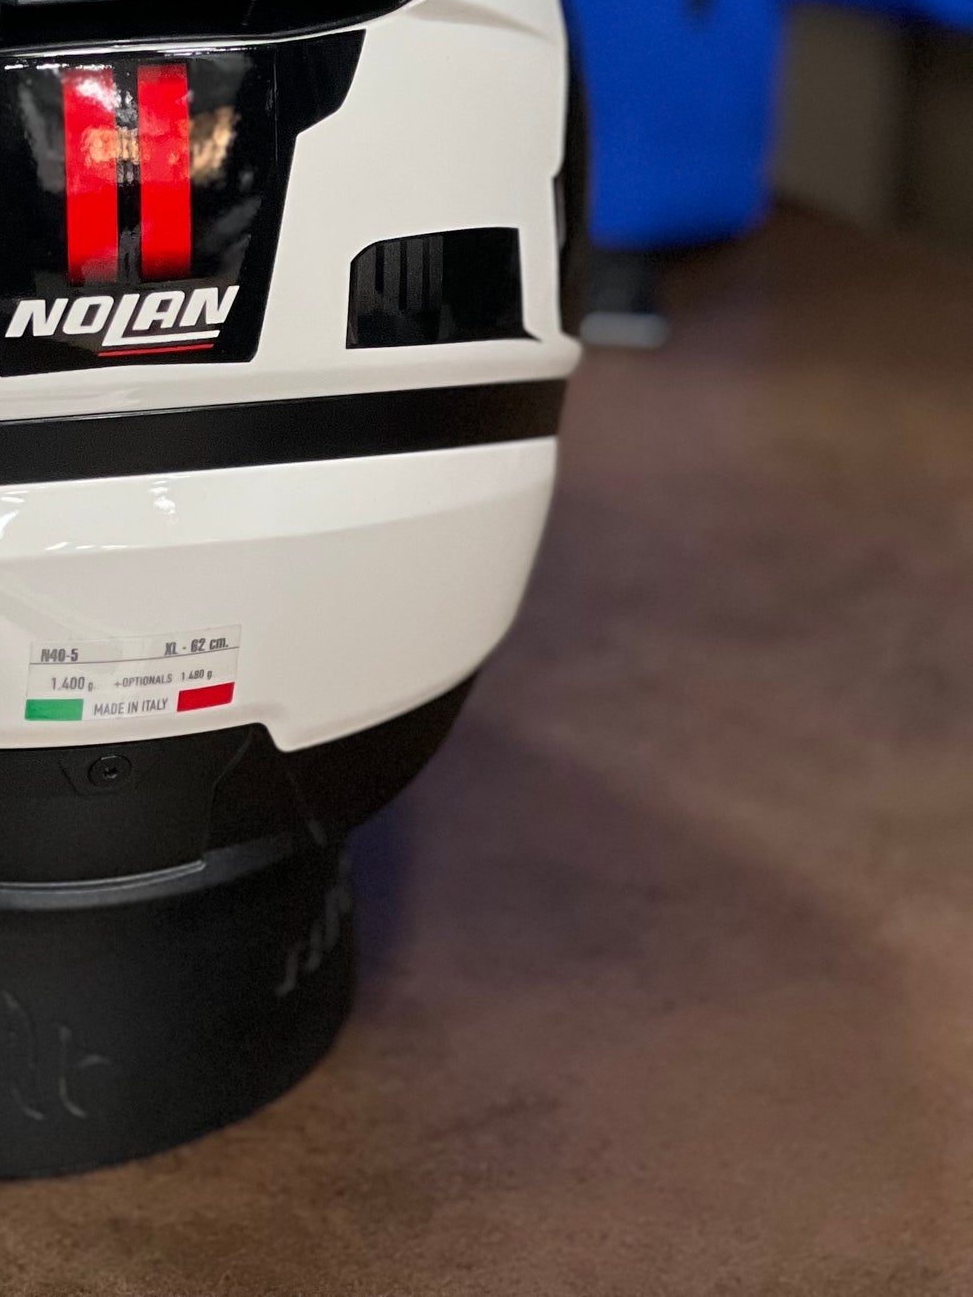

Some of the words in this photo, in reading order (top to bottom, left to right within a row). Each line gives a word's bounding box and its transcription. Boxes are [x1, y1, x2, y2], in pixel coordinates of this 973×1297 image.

[5, 285, 240, 347] NOLAN
[40, 648, 79, 662] N40-5
[164, 642, 178, 656] XL
[191, 638, 206, 653] 62
[93, 703, 124, 716] MADE
[128, 701, 139, 714] IN
[142, 698, 169, 712] ITALY
